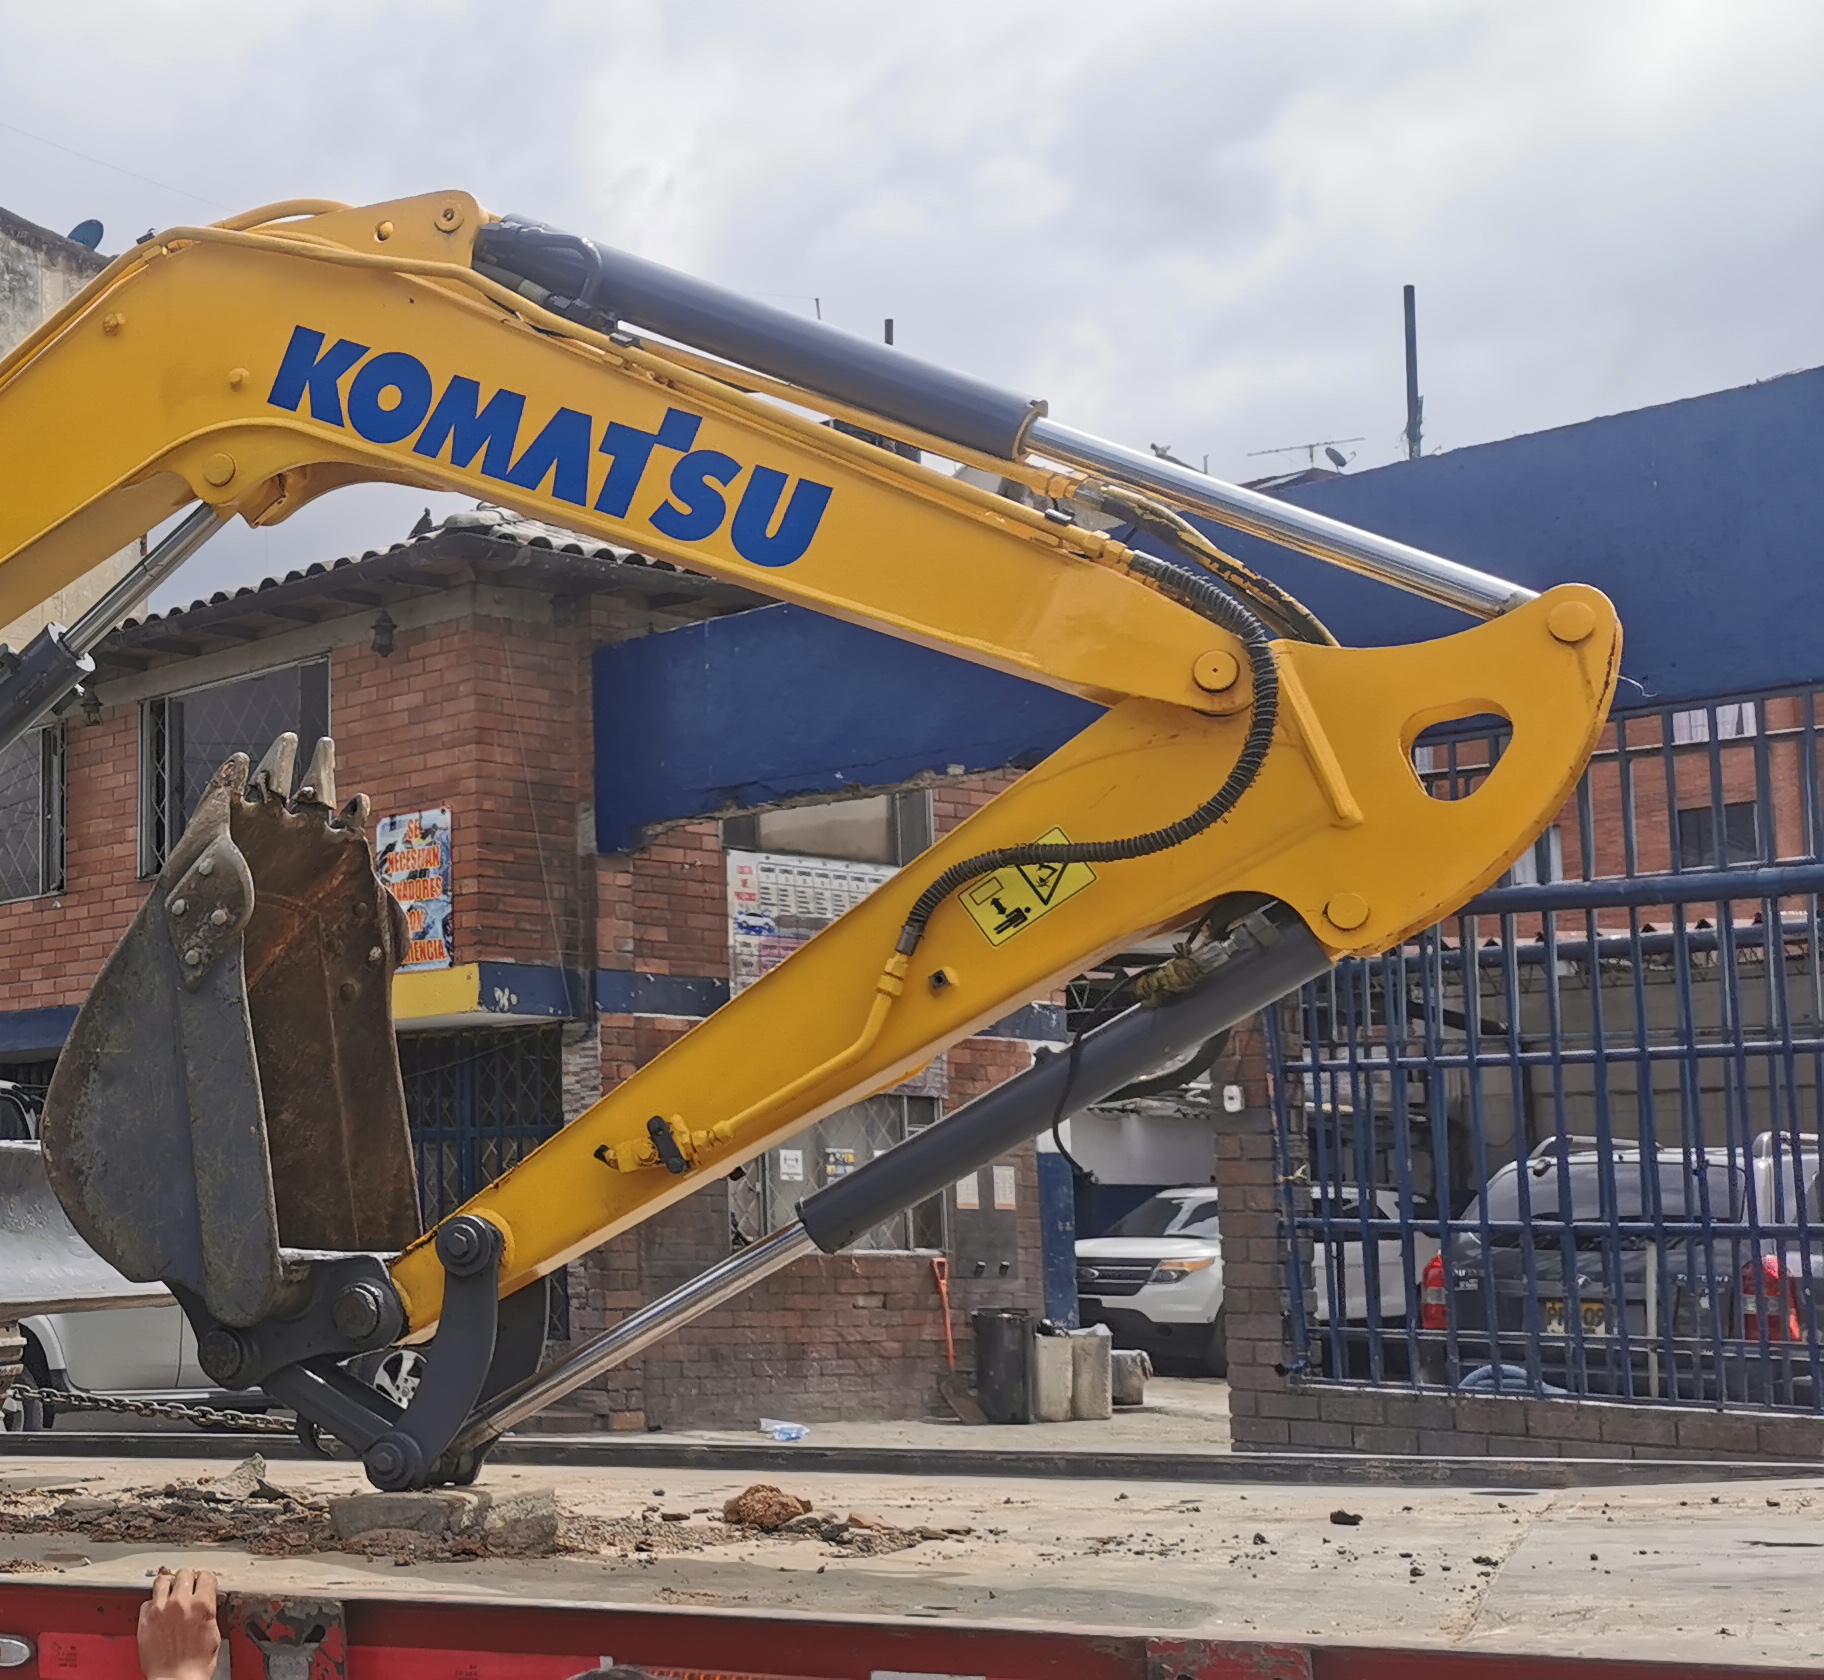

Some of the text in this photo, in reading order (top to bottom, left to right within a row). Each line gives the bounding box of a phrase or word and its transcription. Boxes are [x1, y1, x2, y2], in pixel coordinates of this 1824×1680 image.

[267, 325, 833, 568] KOMATSU
[407, 819, 420, 841] SE
[390, 876, 443, 902] AVADORES
[406, 910, 424, 932] ON
